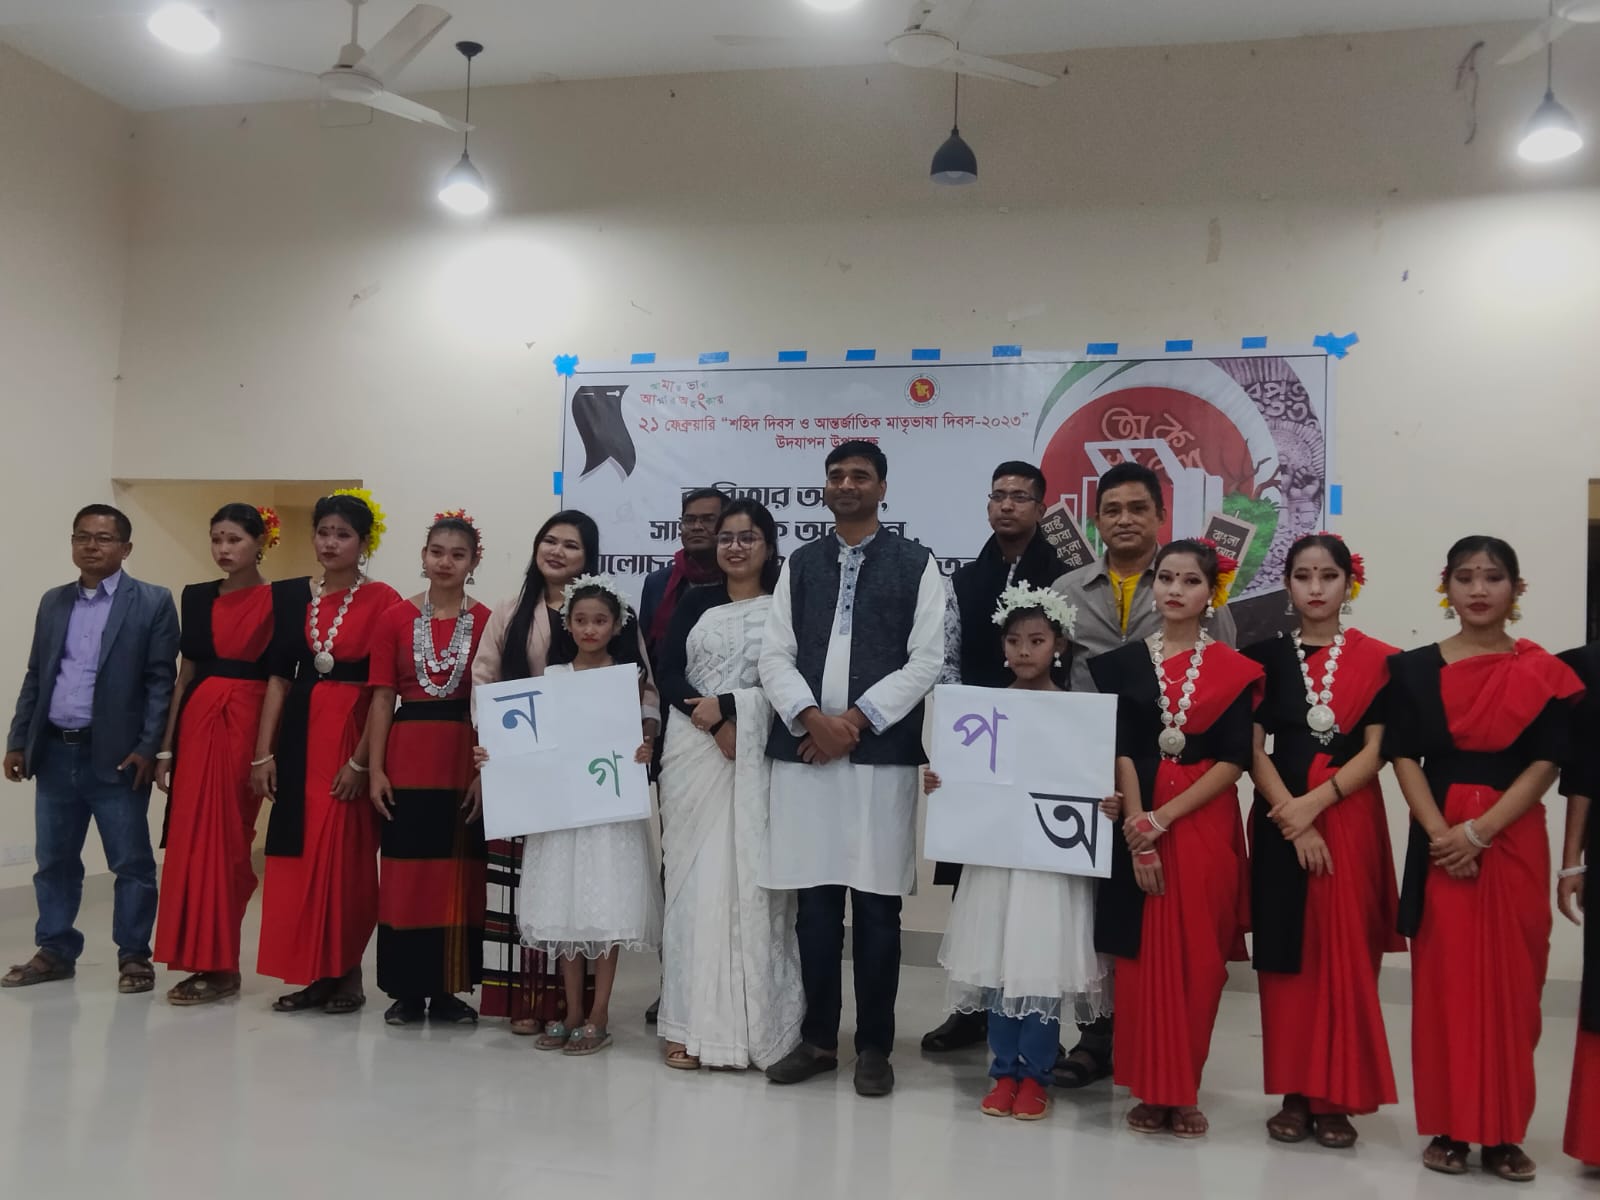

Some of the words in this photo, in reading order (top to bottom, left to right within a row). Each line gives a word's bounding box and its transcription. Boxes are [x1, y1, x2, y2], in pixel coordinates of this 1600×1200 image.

[639, 416, 660, 434] ২১
[764, 414, 794, 432] দিবস
[799, 417, 810, 431] ও
[814, 412, 881, 432] আন্তর্জাতিক
[886, 415, 938, 435] মাতৃভাষা
[775, 434, 826, 450] উদযাপন
[492, 689, 543, 744] ন
[952, 706, 1009, 774] প
[587, 749, 624, 798] গ
[1028, 791, 1104, 869] অ
